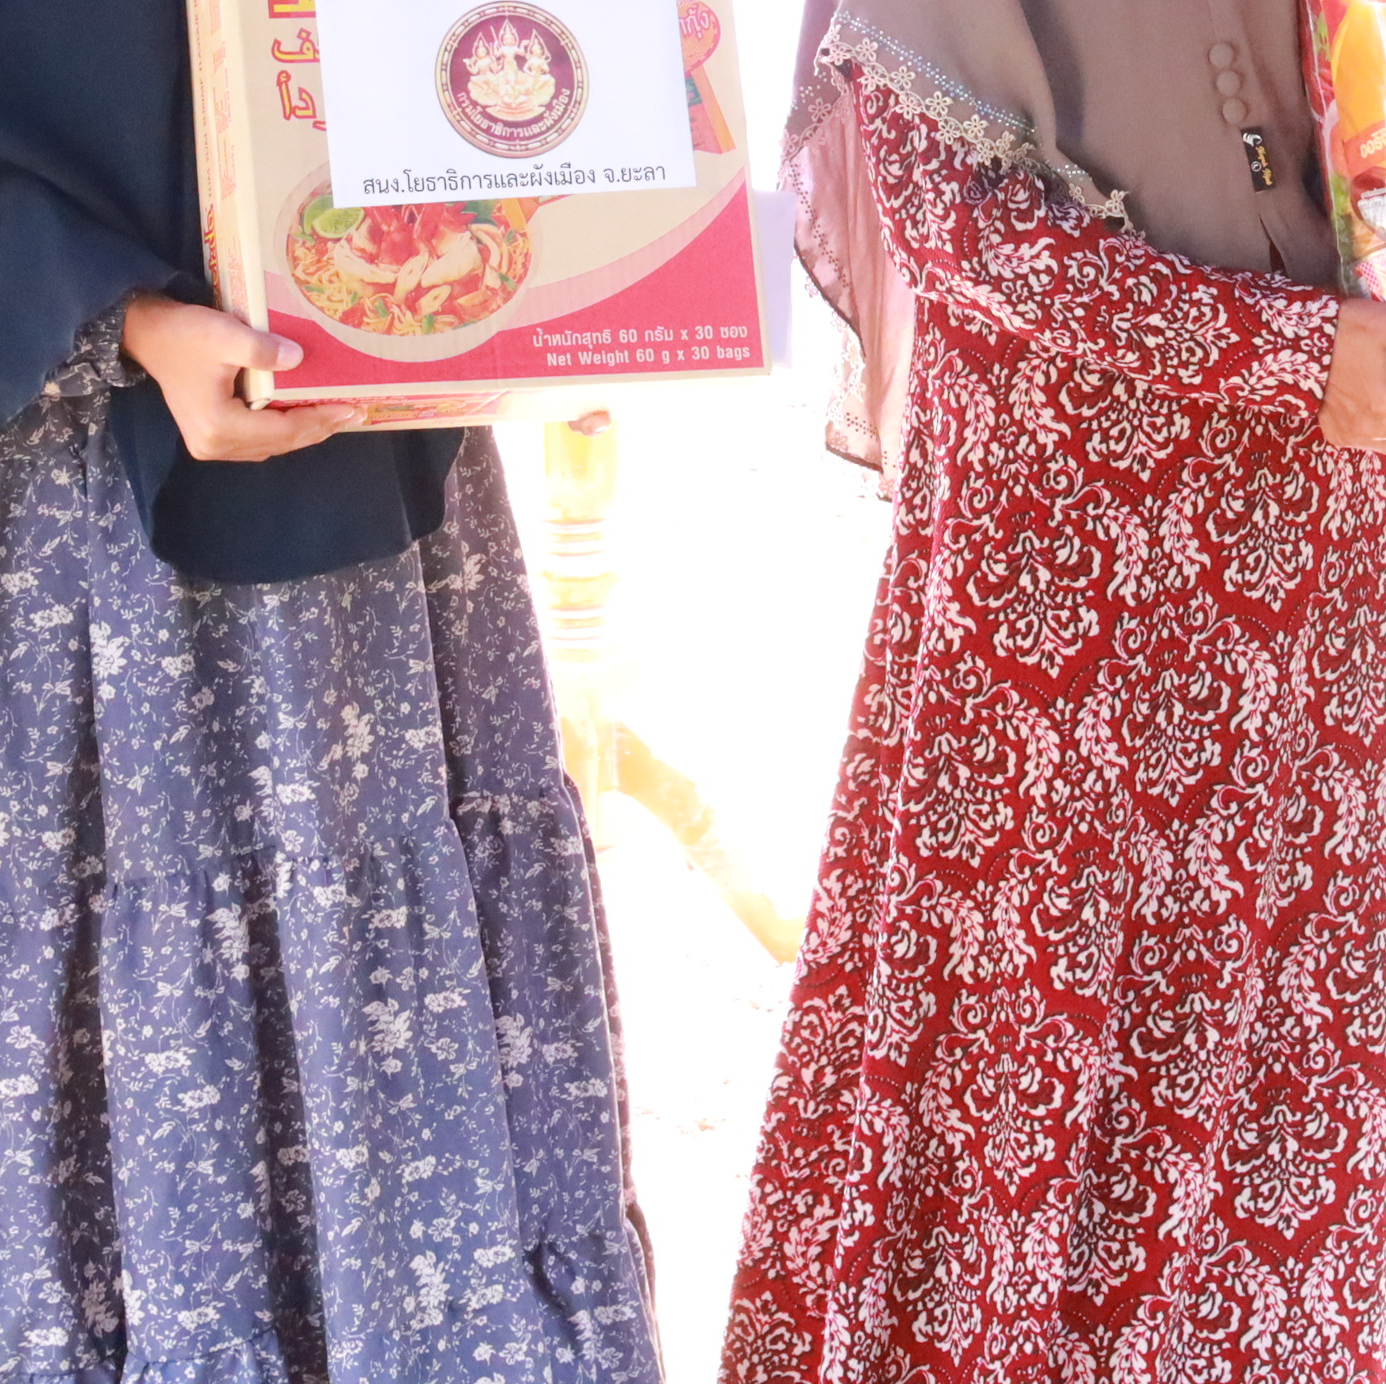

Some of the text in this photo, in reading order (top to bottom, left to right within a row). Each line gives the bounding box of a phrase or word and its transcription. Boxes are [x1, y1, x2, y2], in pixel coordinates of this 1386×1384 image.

[457, 88, 571, 137] กรมโยธาธิการและผังเมือง
[363, 163, 666, 194] สนง.โยธาธิการและผังเมือง จ.ยะลา
[532, 324, 748, 349] น้ำหนักสุทธิ 60 กรัม x 30 ซอง
[547, 344, 751, 367] Net Weight 60 g x 30 bags
